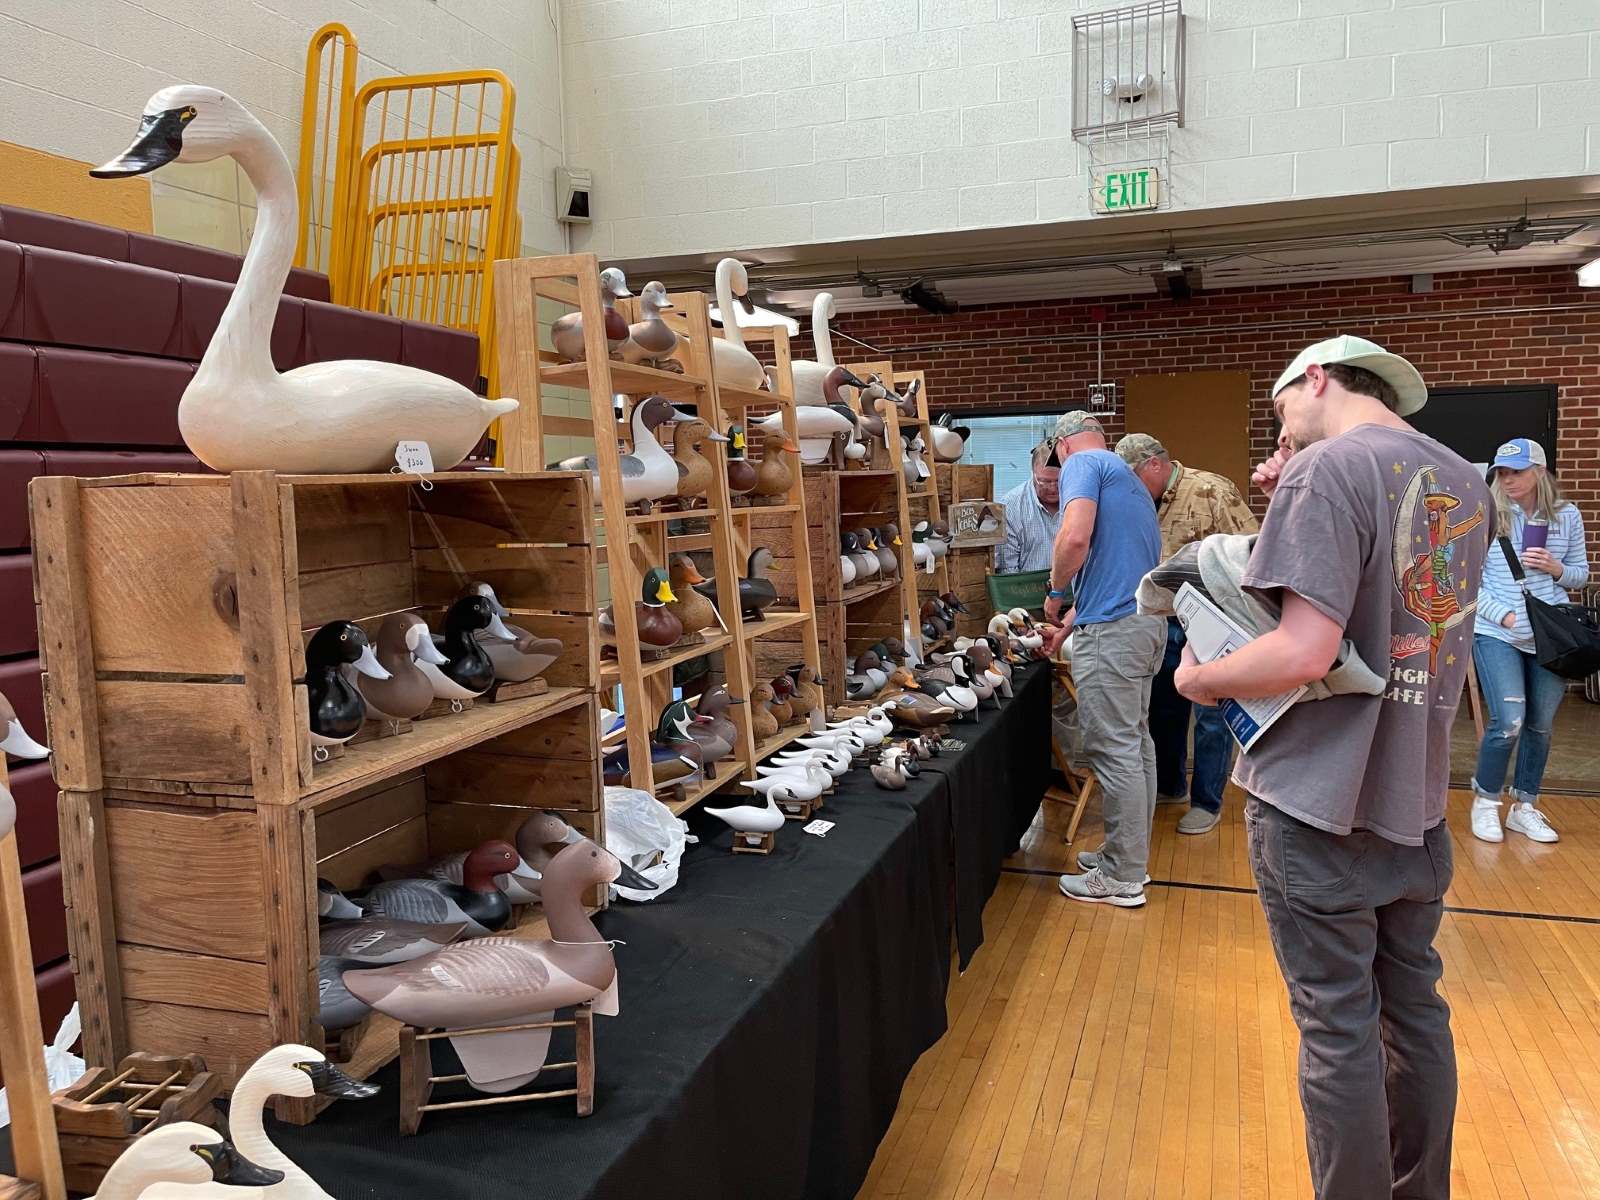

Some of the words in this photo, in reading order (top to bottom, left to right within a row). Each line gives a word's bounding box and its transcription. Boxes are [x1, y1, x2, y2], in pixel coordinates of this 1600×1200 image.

[1106, 171, 1149, 208] EXIT
[407, 458, 424, 468] $300
[1391, 666, 1428, 685] IGH
